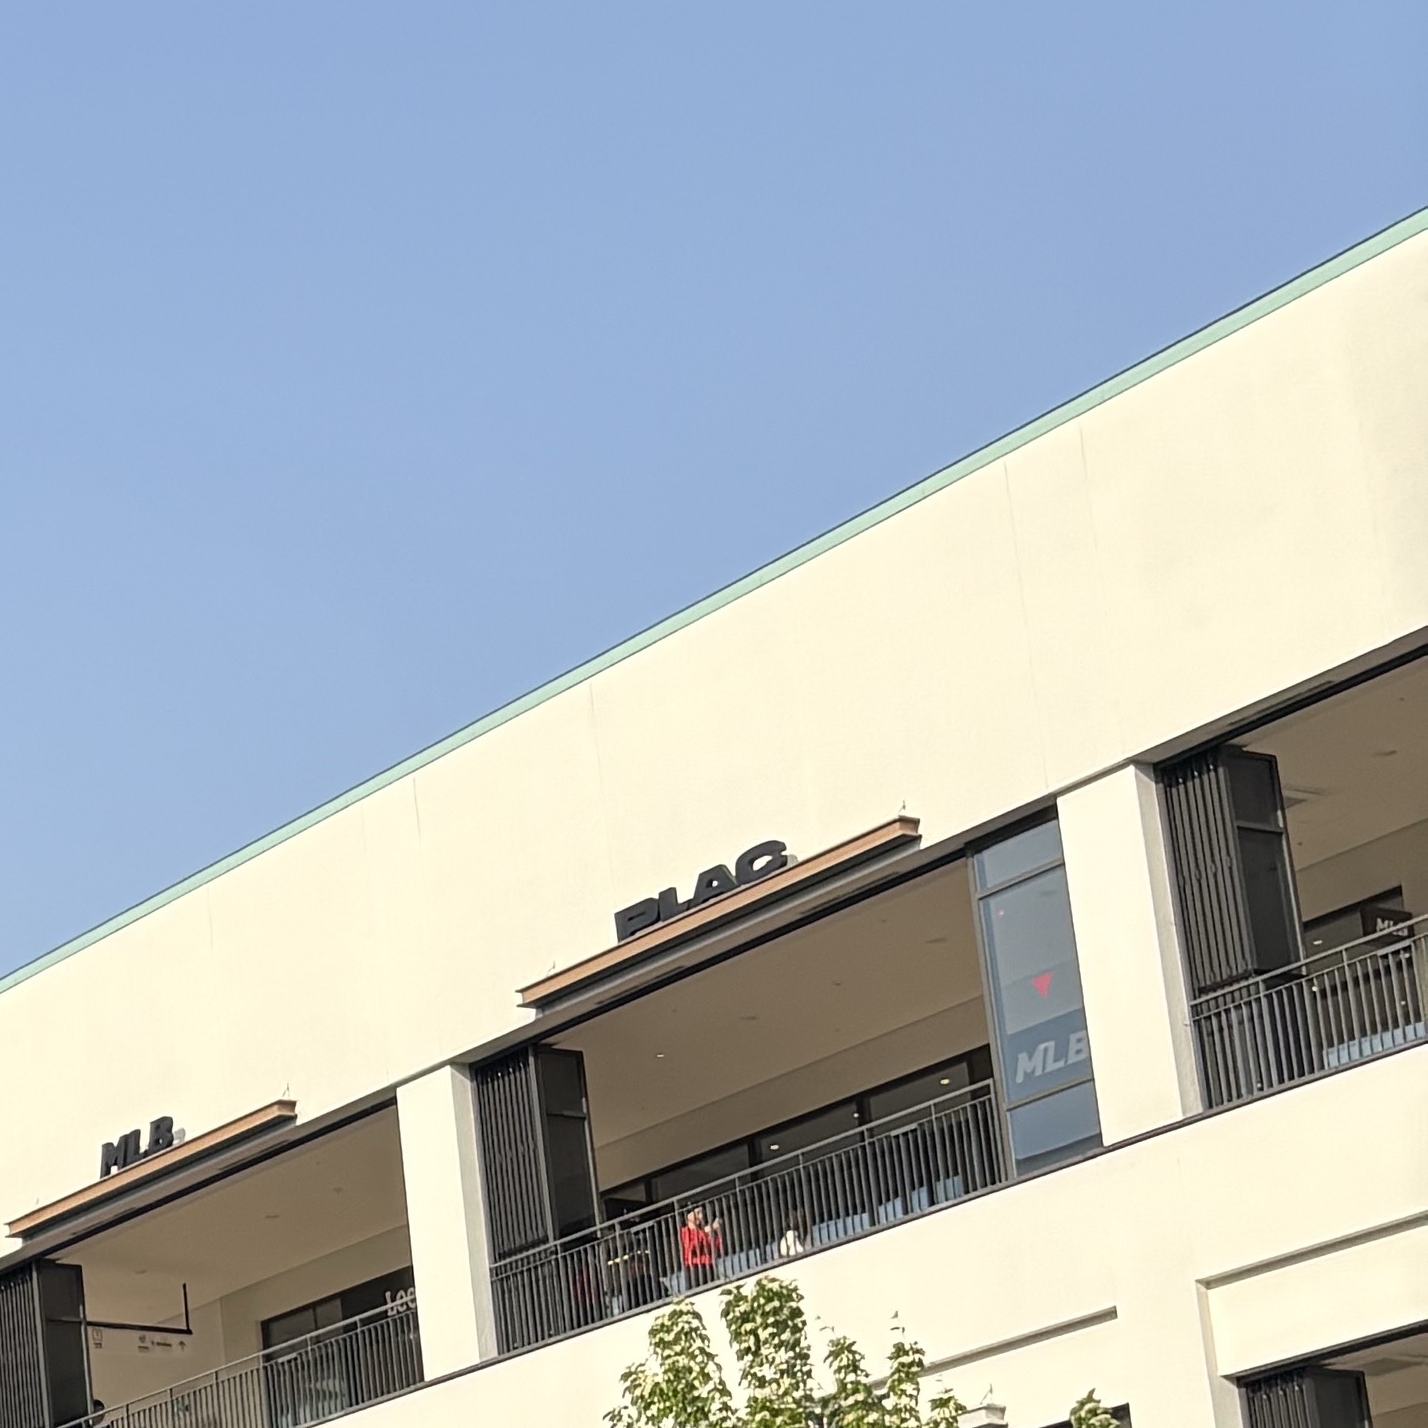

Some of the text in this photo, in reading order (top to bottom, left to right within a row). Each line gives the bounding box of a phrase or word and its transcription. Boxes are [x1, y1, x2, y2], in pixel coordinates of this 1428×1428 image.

[614, 840, 788, 943] PLAC
[1015, 1030, 1090, 1084] MLB
[99, 1116, 175, 1180] MLB
